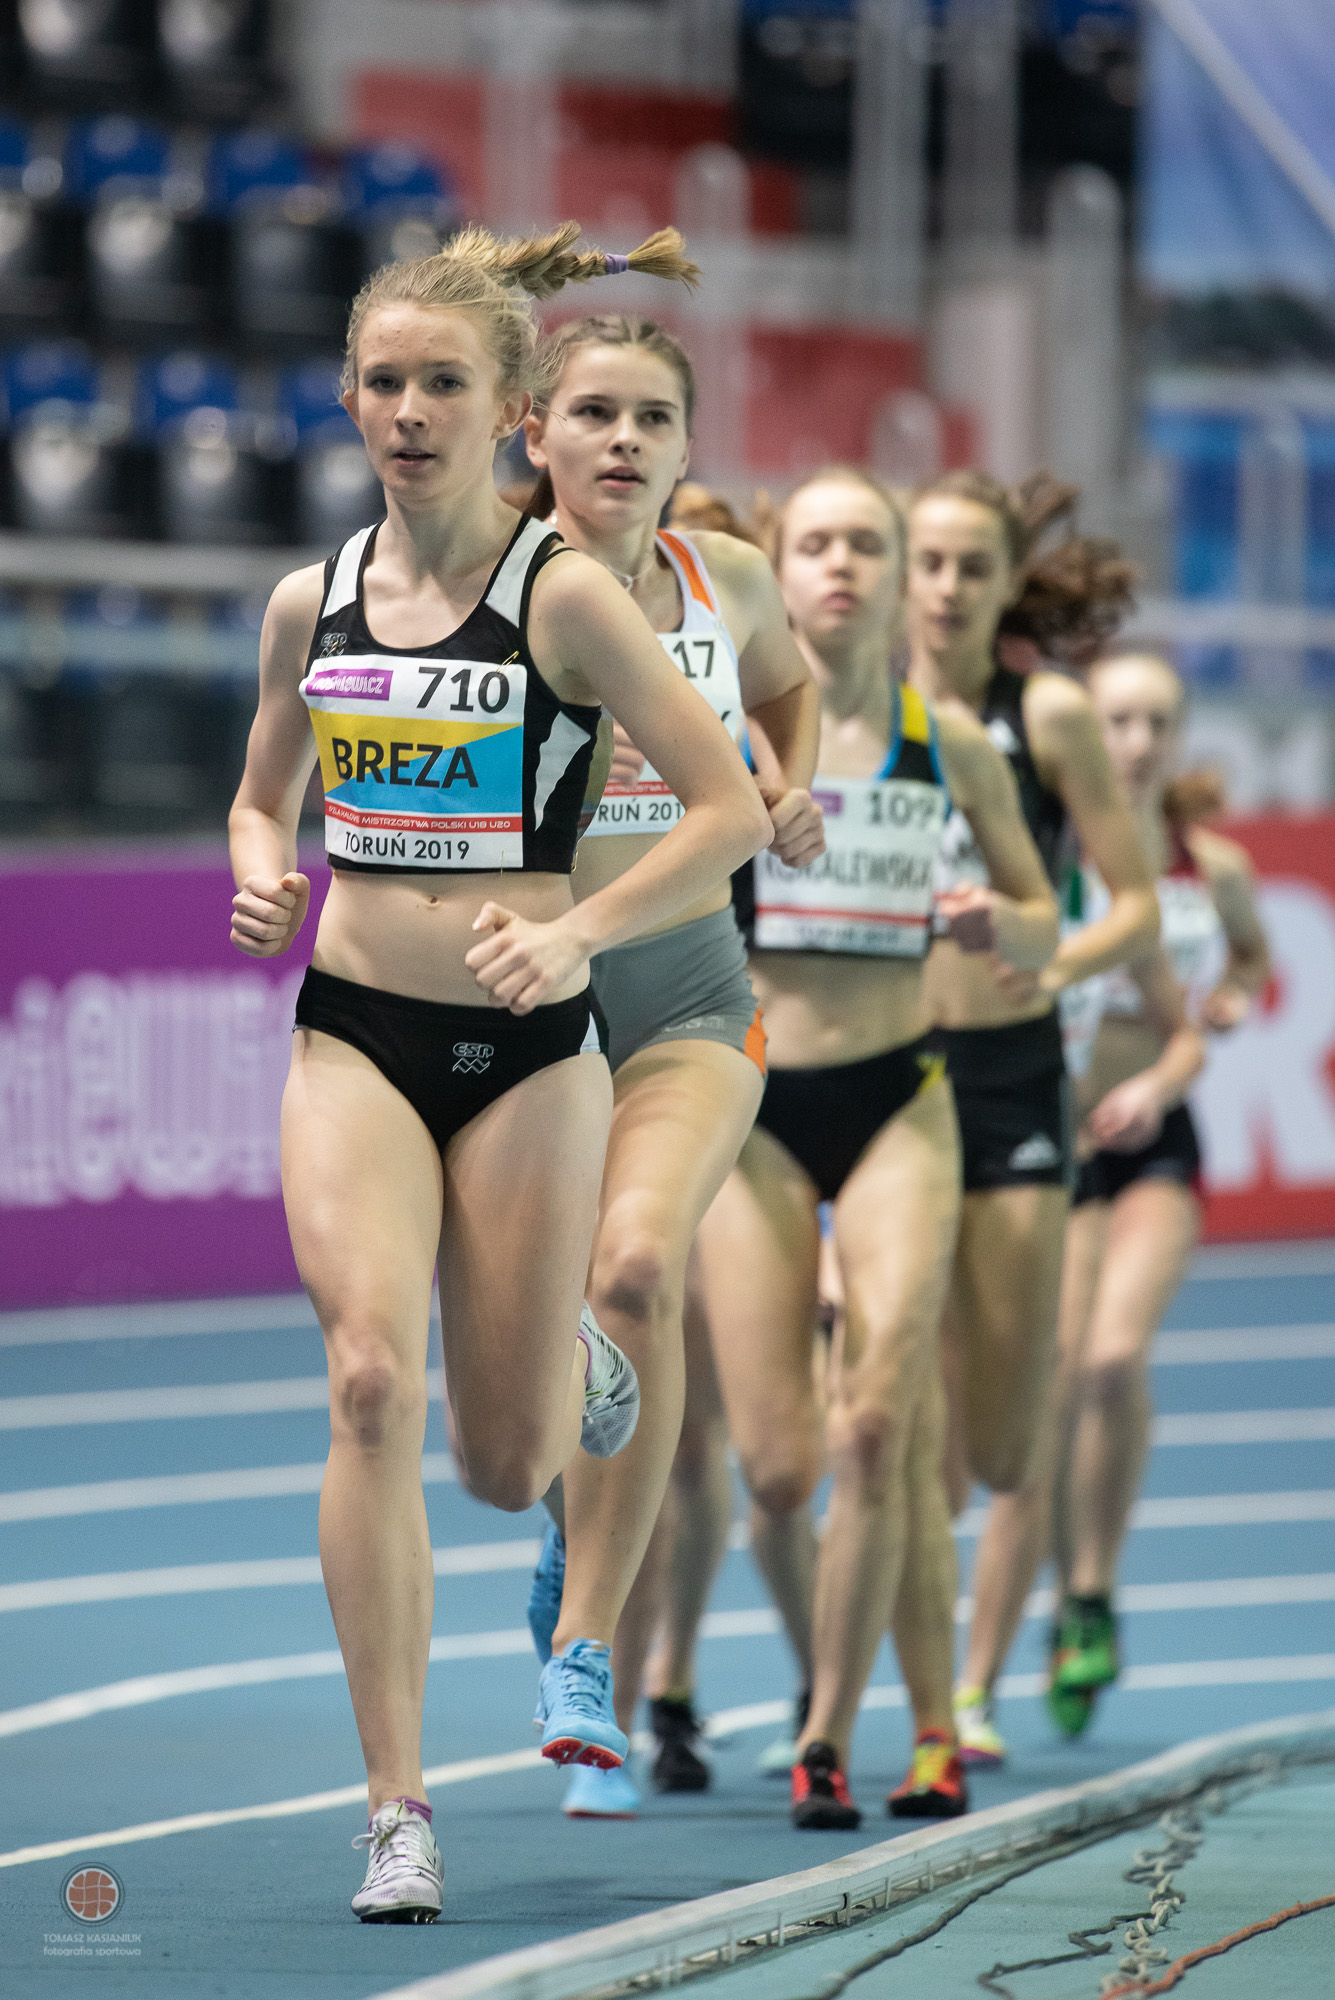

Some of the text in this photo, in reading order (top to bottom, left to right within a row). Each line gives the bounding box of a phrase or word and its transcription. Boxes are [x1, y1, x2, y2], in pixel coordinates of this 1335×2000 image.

[671, 640, 715, 679] 17
[416, 666, 511, 713] 710
[332, 737, 479, 789] BREZA
[361, 816, 429, 829] MISTRZOSTWA
[430, 820, 467, 829] POLSKI
[489, 820, 511, 829] U20
[598, 797, 681, 822] RUŃ 201
[345, 832, 470, 860] TORUŃ 2019
